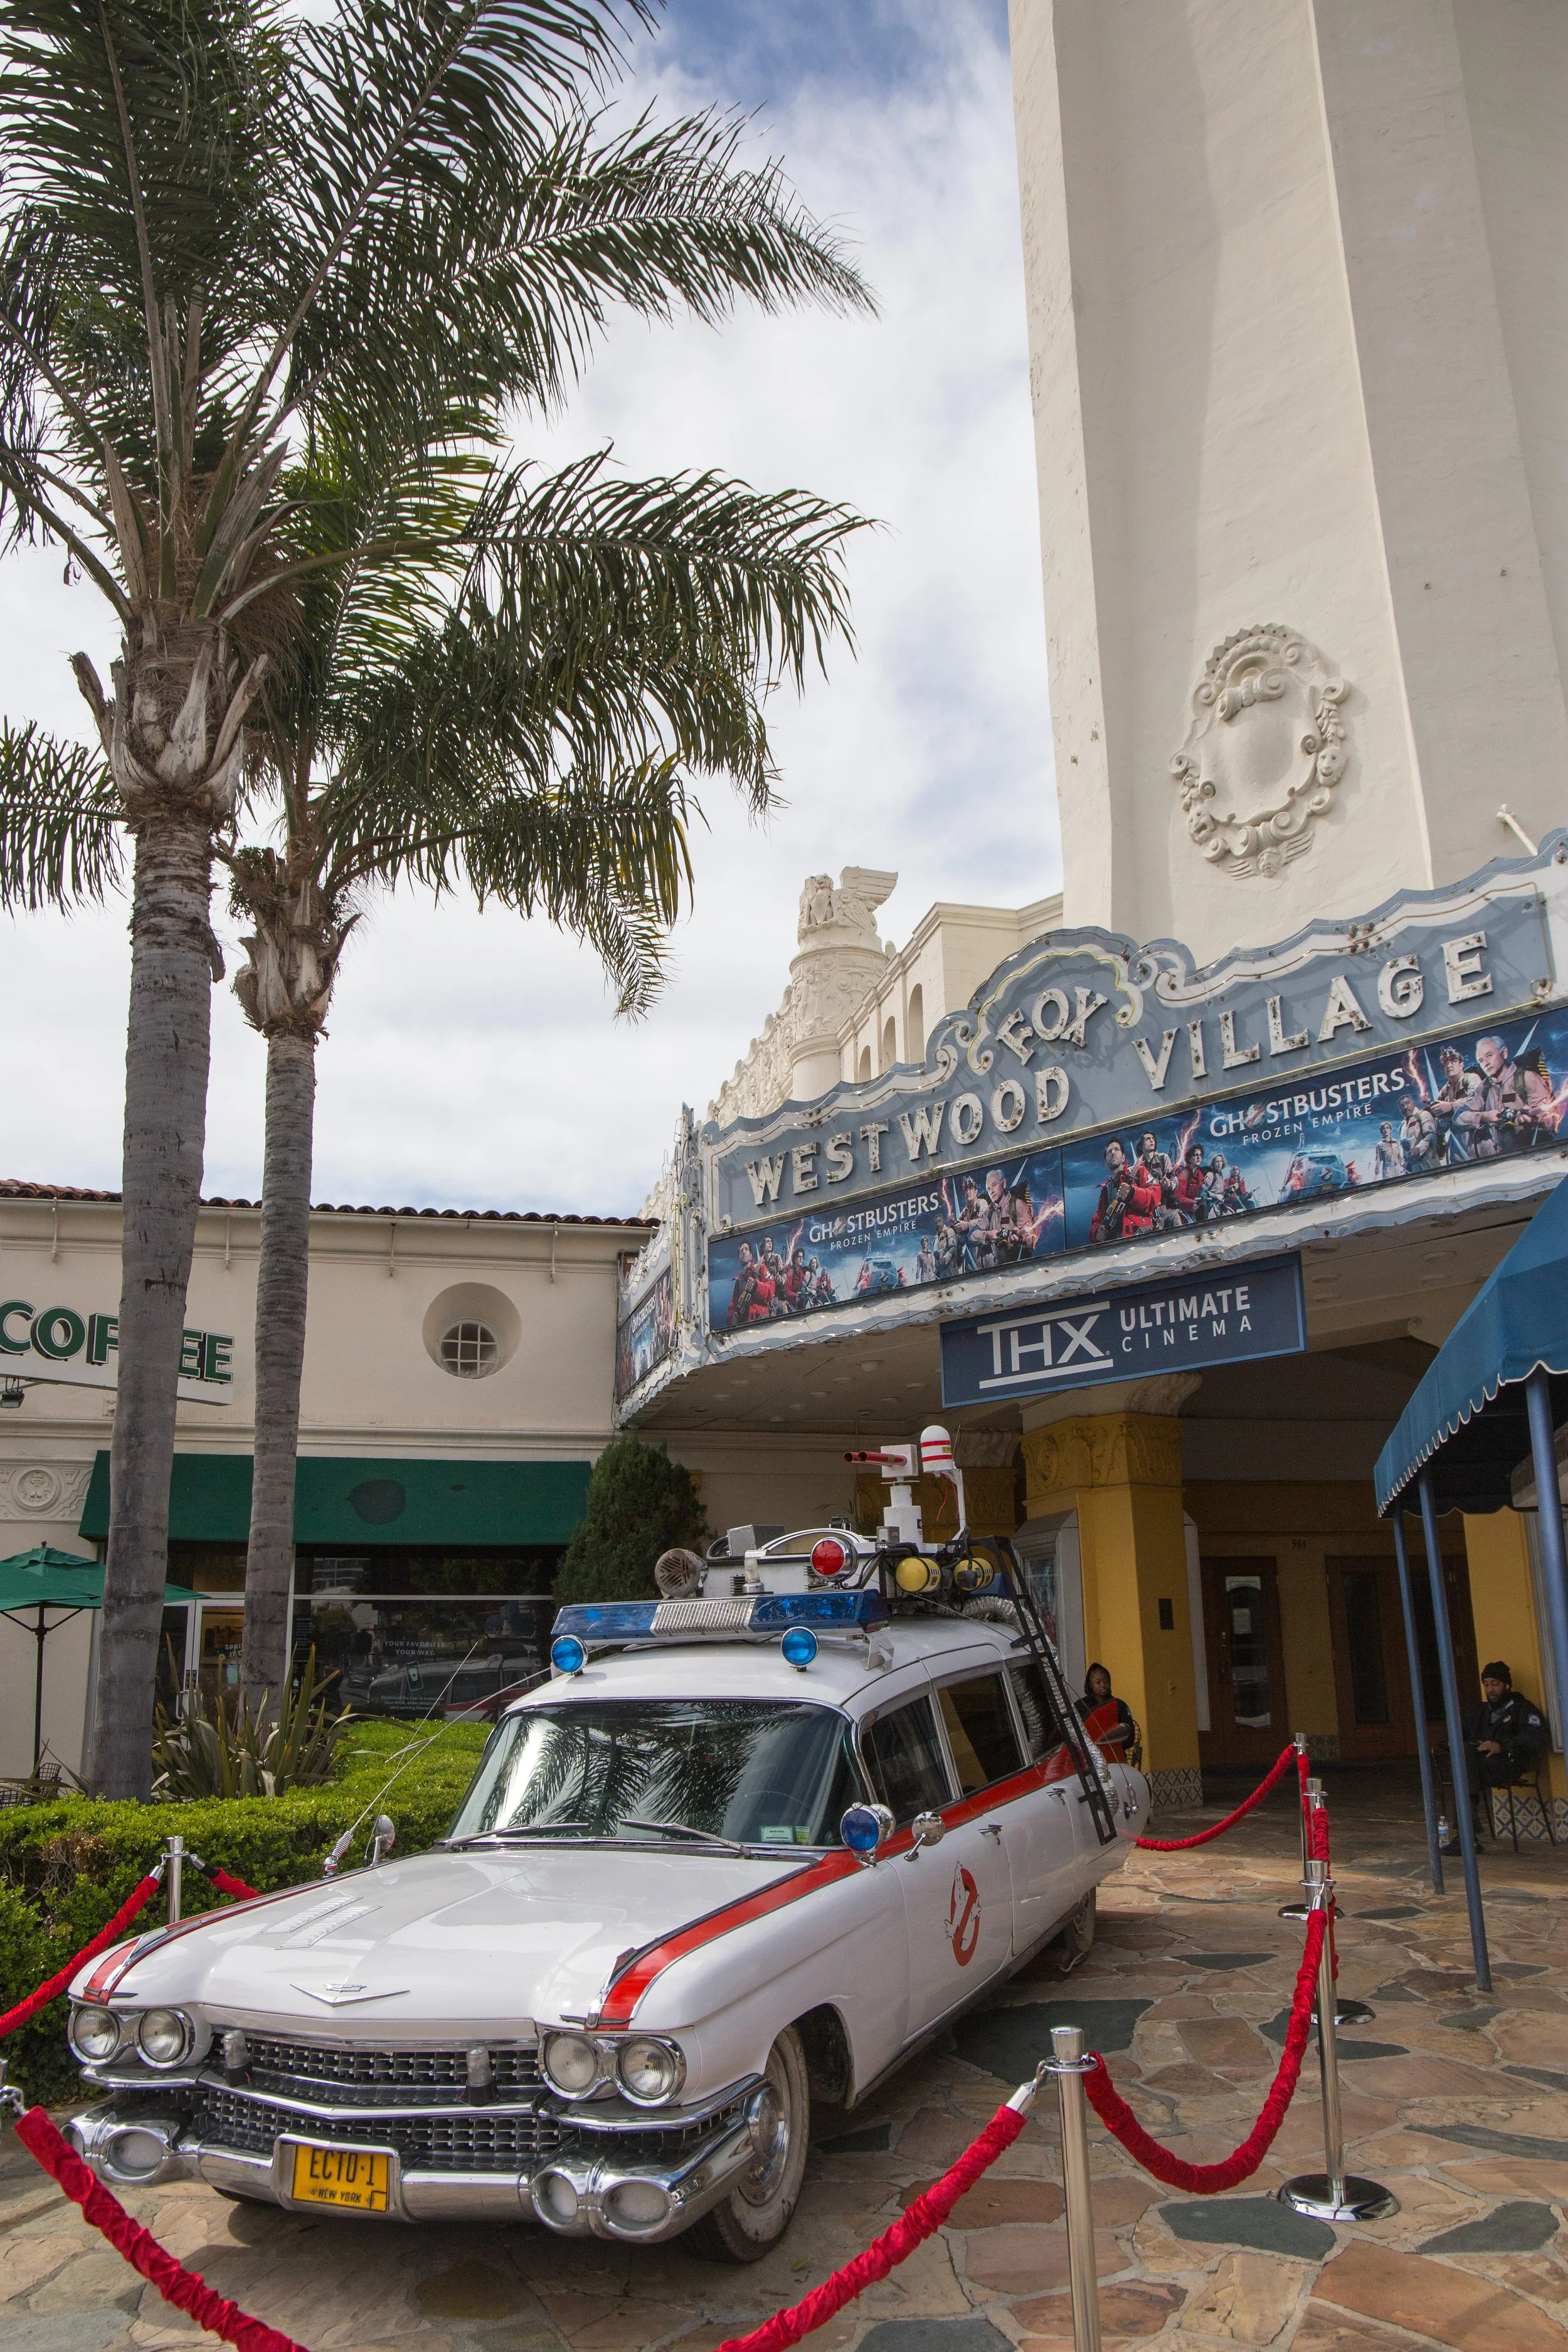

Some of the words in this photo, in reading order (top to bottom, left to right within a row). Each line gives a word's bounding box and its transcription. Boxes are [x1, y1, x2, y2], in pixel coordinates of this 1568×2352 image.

[995, 987, 1108, 1066] FOX
[744, 1066, 1070, 1206] WESTWOOD
[1132, 930, 1494, 1091] VILLAGE
[1243, 1121, 1303, 1145] FROZEN
[1312, 1104, 1372, 1128] EMPIRE
[830, 1233, 871, 1251] FROZEN
[877, 1221, 916, 1239] EMPIRE
[1120, 1286, 1250, 1332] ULTIMATE
[0, 1300, 235, 1384] COFEE
[977, 1301, 1110, 1375] THX
[1121, 1315, 1252, 1352] CINEMA
[318, 2188, 337, 2200] NEW
[341, 2191, 362, 2203] YORK
